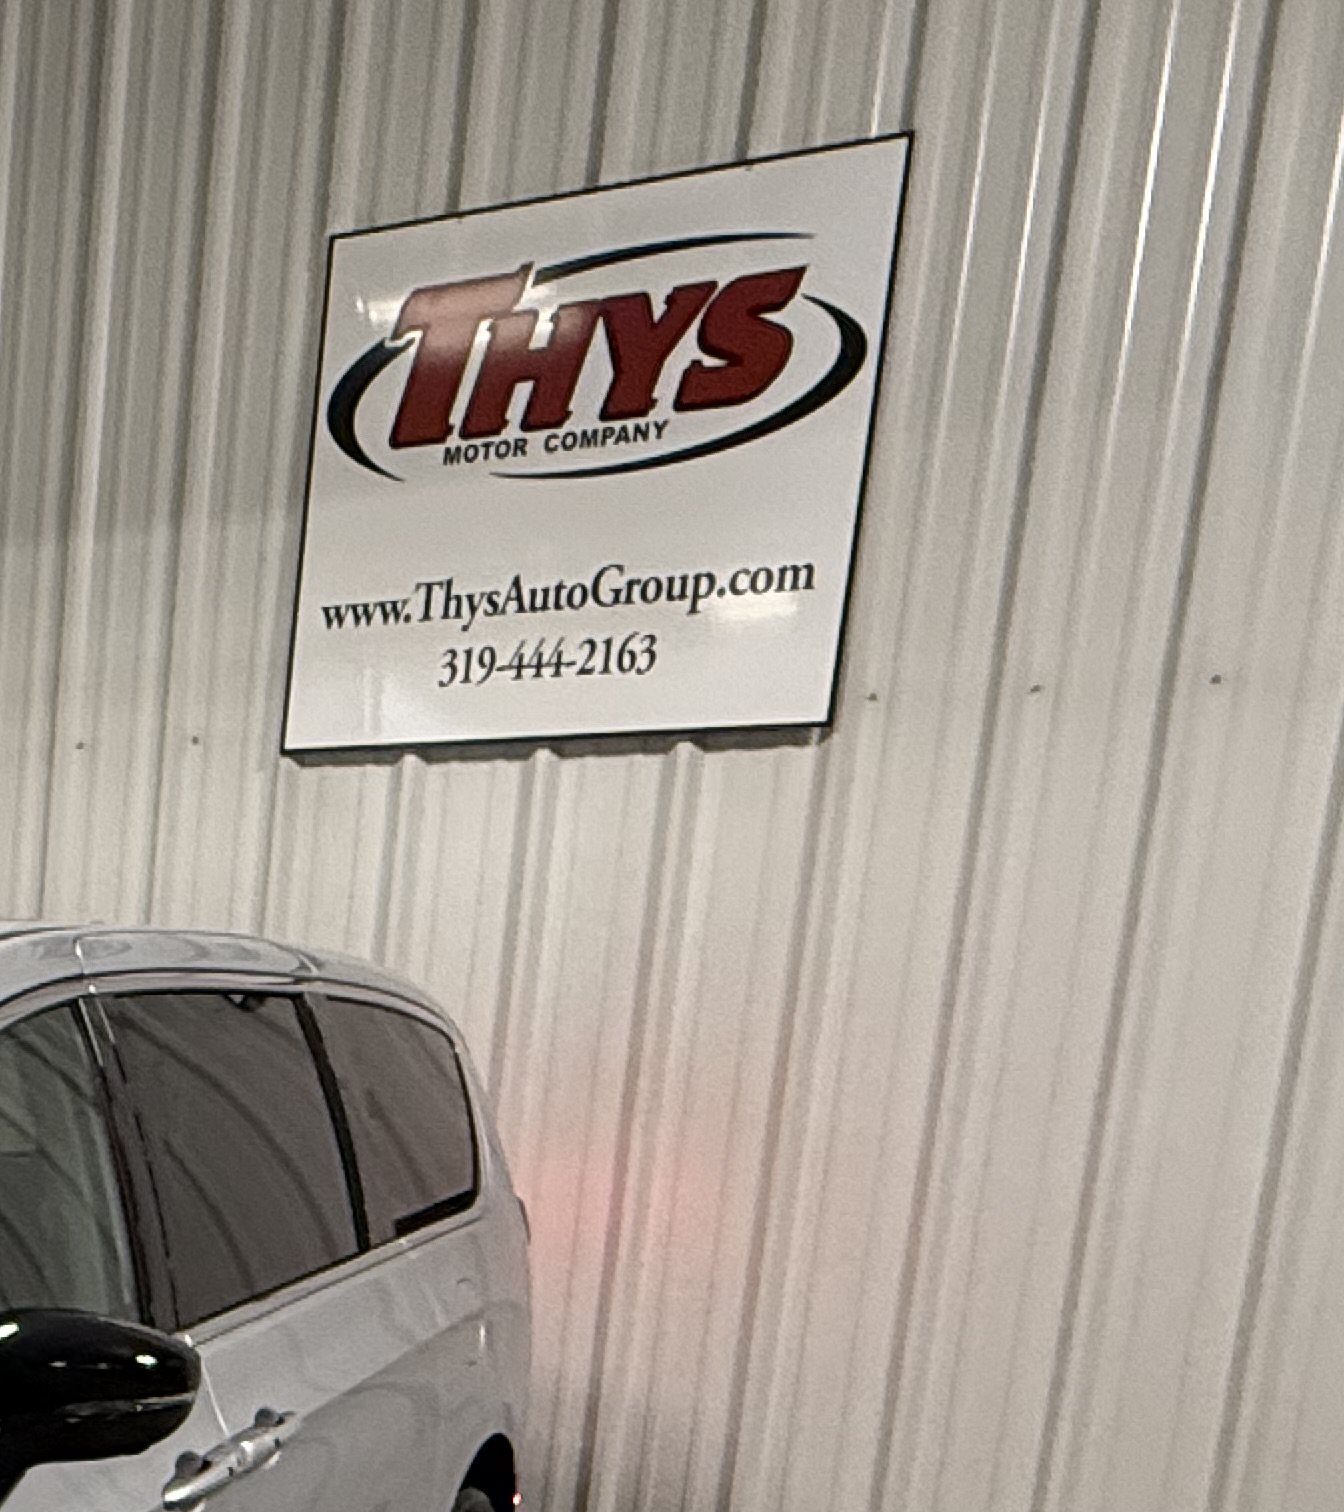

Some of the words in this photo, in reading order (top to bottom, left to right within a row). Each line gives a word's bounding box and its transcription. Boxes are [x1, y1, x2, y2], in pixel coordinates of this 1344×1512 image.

[389, 261, 809, 450] THYS
[442, 438, 528, 466] MOTOR
[543, 419, 670, 454] COMPANY
[320, 561, 816, 632] www.ThysAutoGroup.com
[437, 633, 658, 688] 319-444-2163
